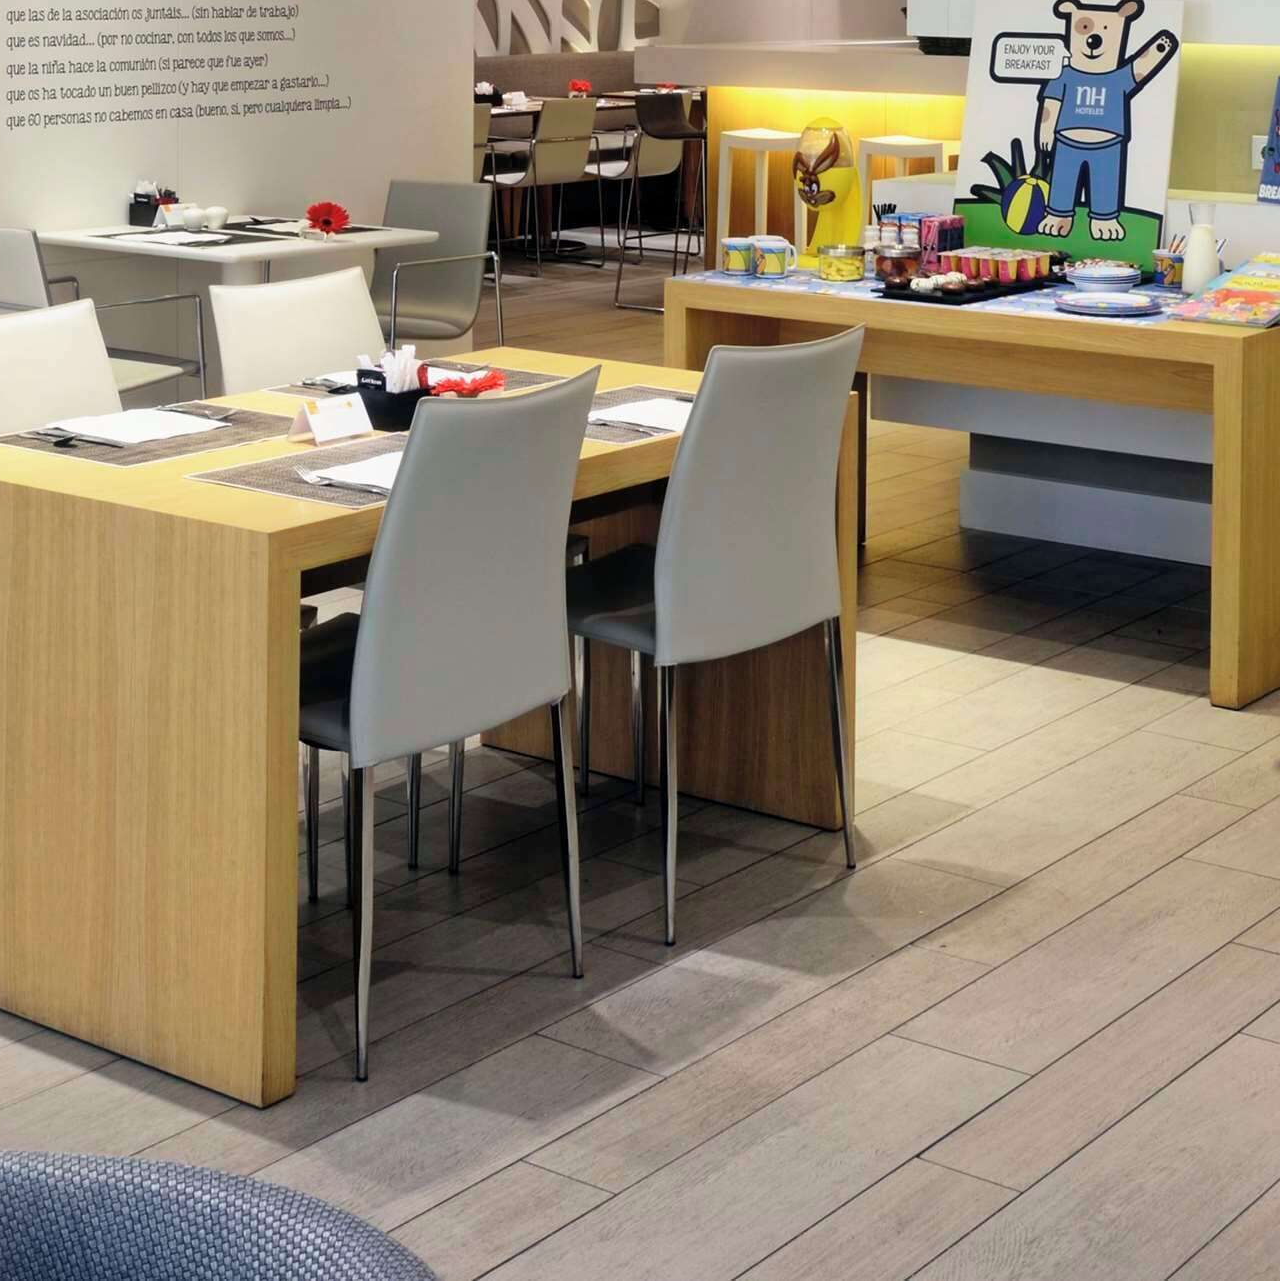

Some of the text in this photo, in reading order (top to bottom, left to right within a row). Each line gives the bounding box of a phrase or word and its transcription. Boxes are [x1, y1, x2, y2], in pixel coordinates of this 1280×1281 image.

[6, 10, 26, 24] que
[28, 7, 45, 21] las
[75, 6, 129, 20] asociación
[6, 36, 26, 50] que
[1004, 43, 1055, 56] ENJOY YOUR
[6, 56, 156, 78] que niña hace comunión
[1005, 59, 1052, 71] BREAKFAST
[6, 80, 177, 104] que tocado buen pellizco
[6, 106, 193, 130] que personas cabemos casa
